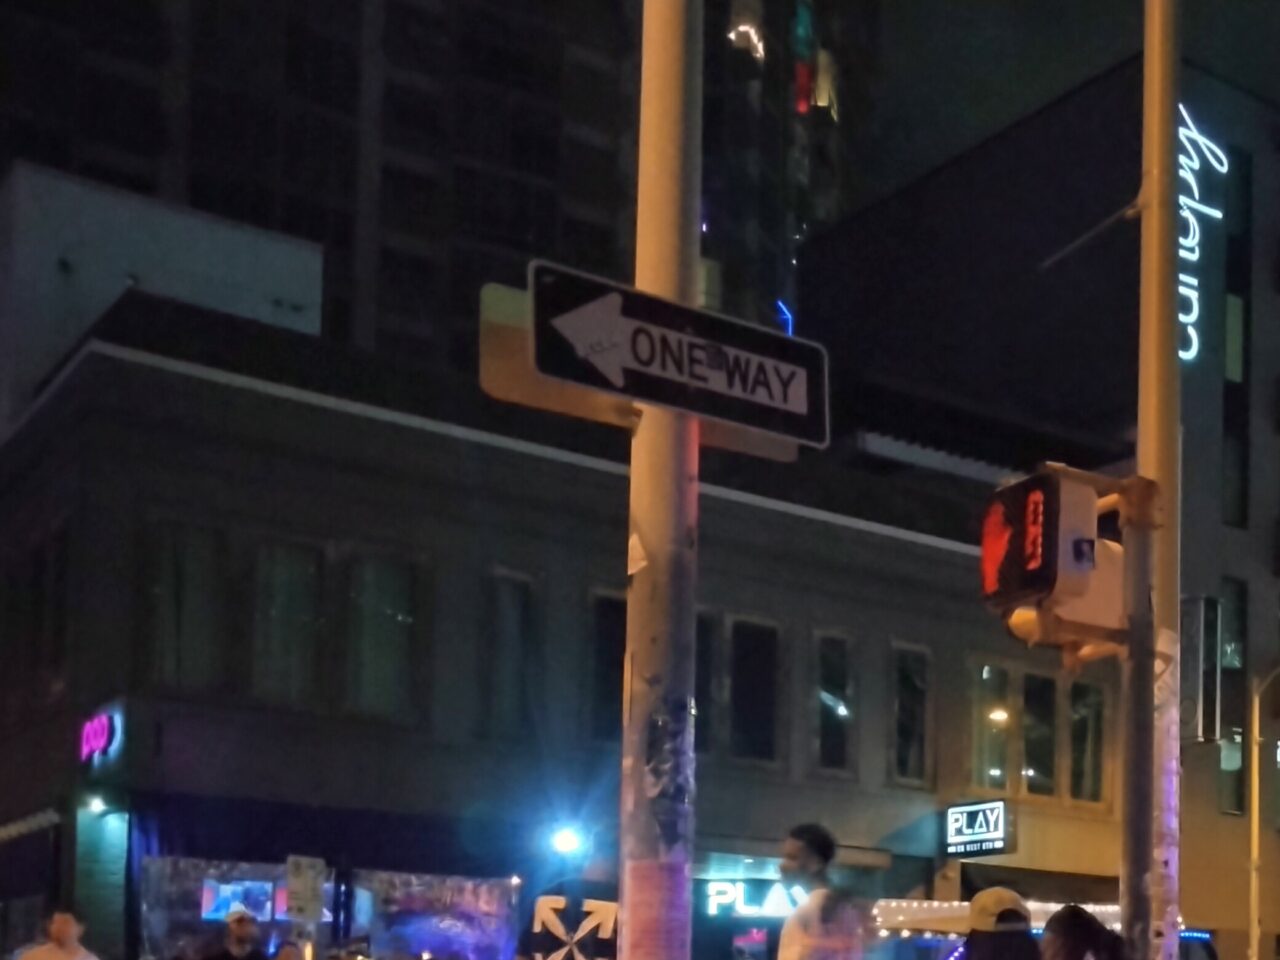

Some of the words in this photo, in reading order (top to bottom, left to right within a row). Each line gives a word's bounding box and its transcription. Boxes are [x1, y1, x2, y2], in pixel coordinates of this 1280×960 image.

[631, 326, 709, 384] ONE
[724, 352, 797, 404] WAY
[951, 808, 1000, 837] PLAY
